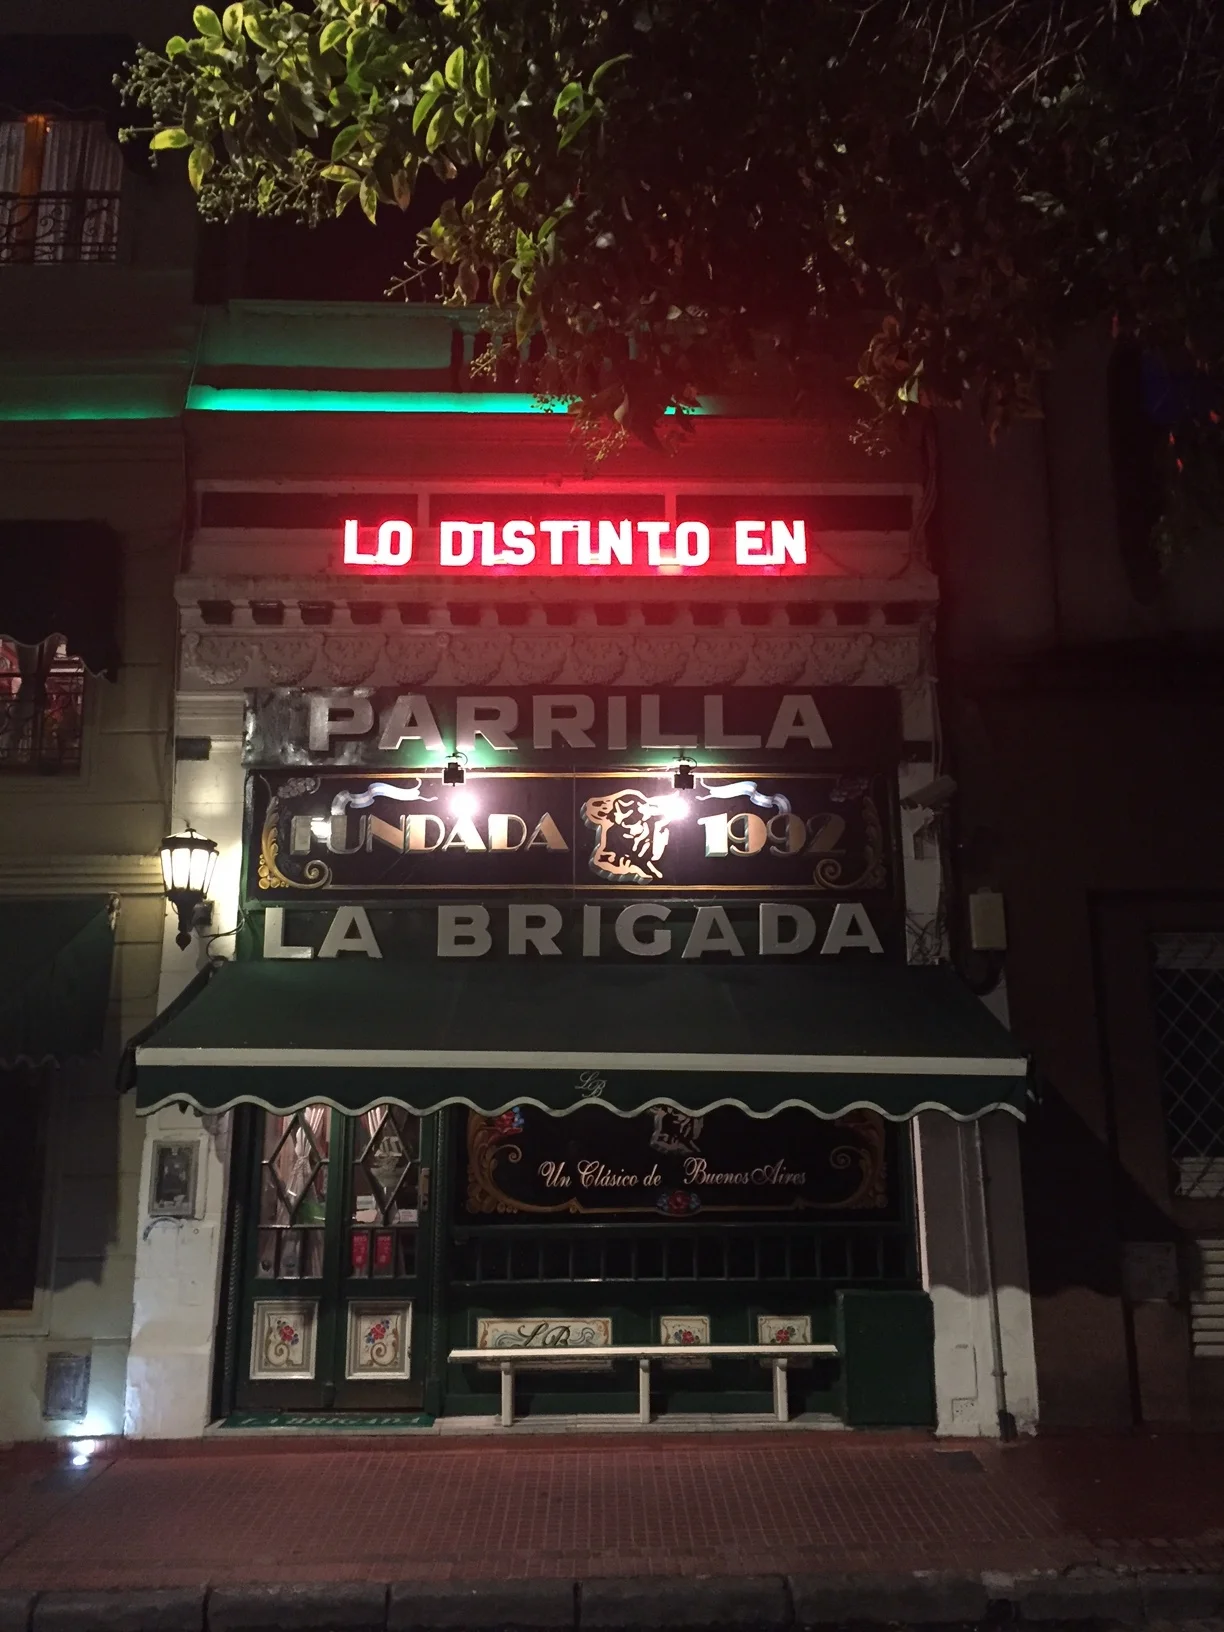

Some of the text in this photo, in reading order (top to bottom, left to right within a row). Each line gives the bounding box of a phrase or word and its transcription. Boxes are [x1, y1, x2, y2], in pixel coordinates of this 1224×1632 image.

[343, 518, 808, 566] LO DISTINTO EN
[308, 693, 833, 752] PARRILLA
[290, 811, 847, 858] FUNDADA 1992
[262, 902, 885, 960] LA BRIGADA
[537, 1156, 807, 1189] Un Clásico de Buenos Aires
